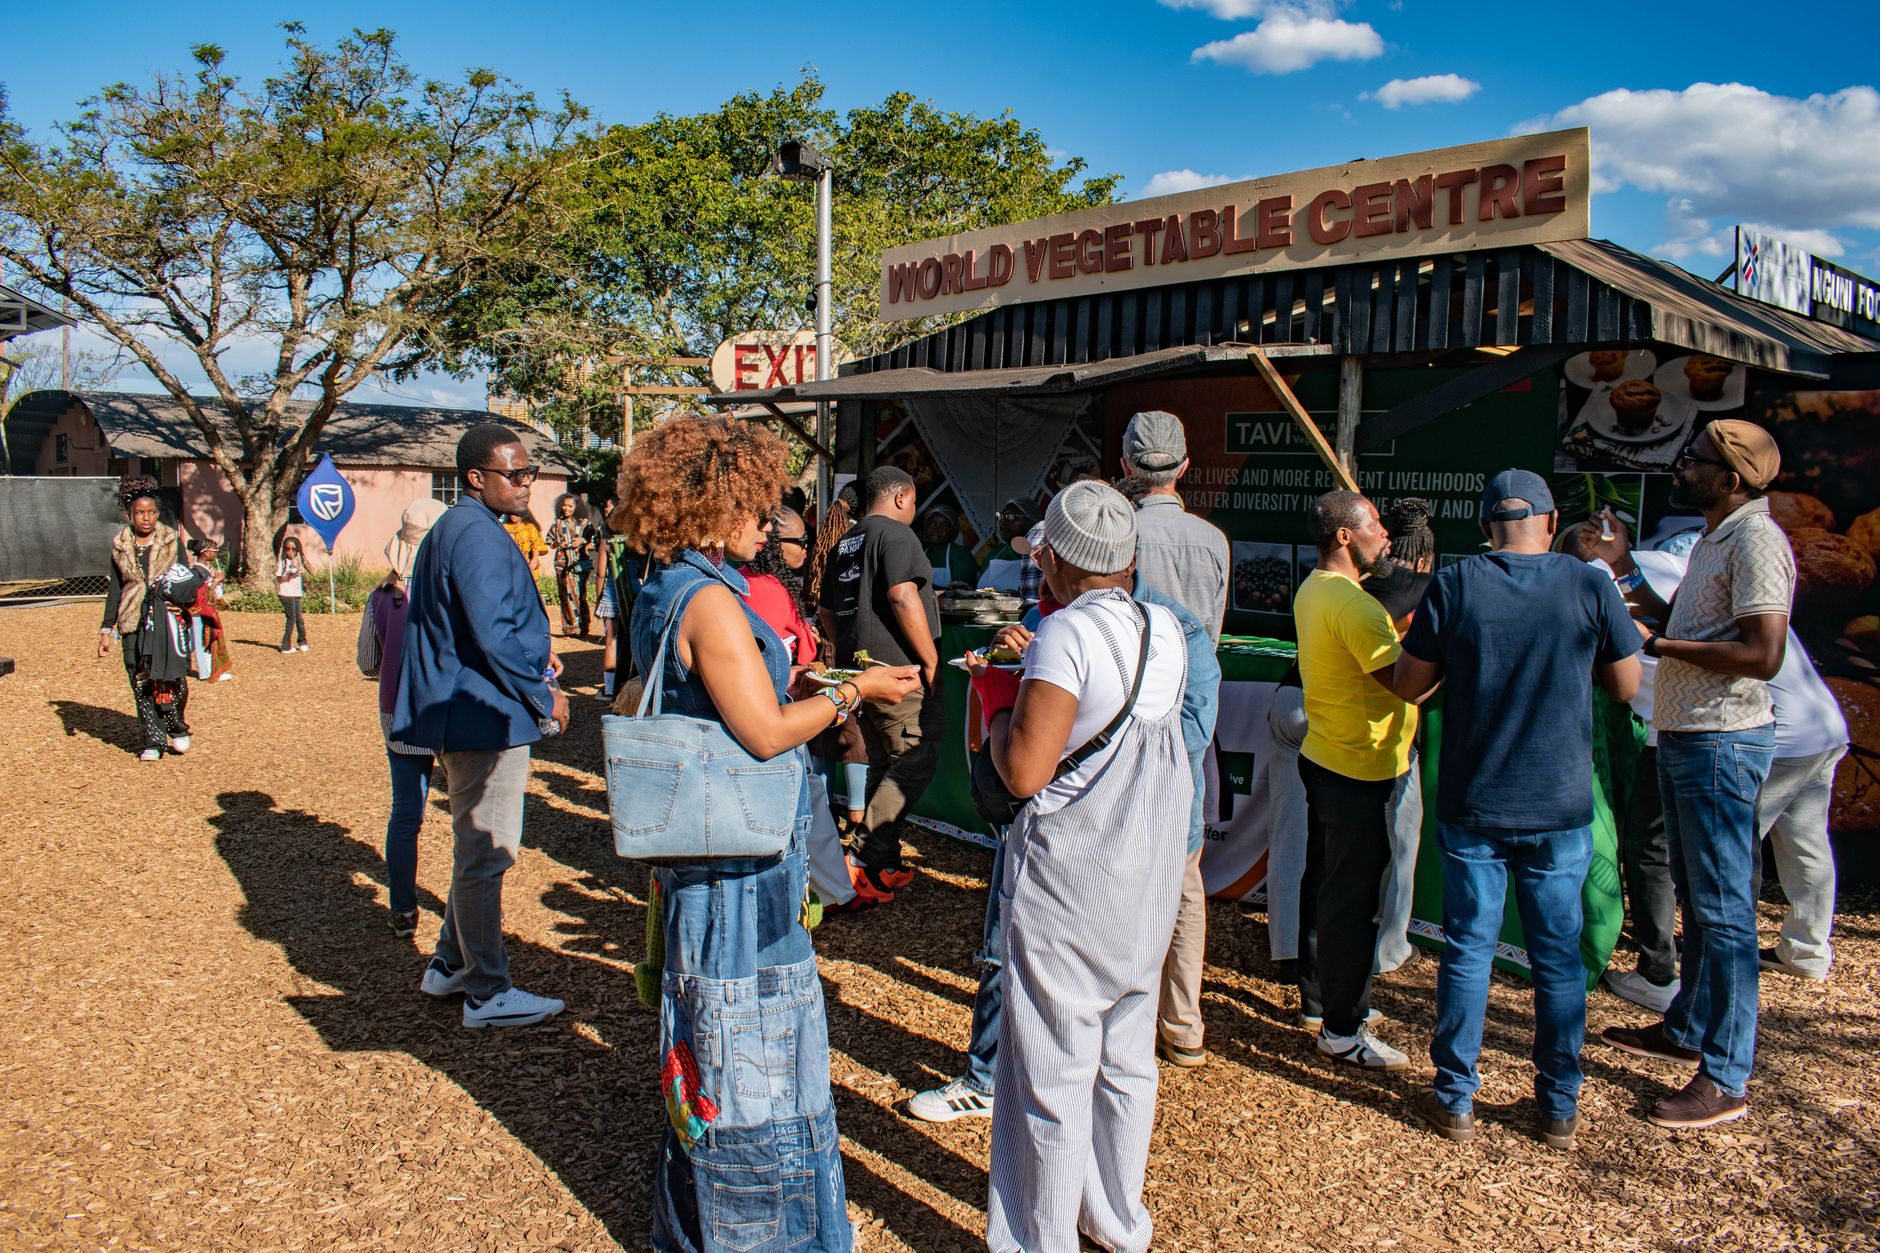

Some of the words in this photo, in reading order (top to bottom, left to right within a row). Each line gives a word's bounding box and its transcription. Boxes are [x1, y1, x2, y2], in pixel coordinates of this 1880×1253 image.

[889, 243, 1014, 303] WORLD
[1024, 194, 1294, 284] VEGETABLE
[1308, 155, 1566, 244] CENTRE
[1811, 266, 1853, 312] NGUNI
[1235, 422, 1291, 445] TAVI
[1206, 468, 1239, 485] LIVES
[1242, 468, 1269, 487] AND
[1272, 469, 1311, 488] MORE
[1388, 471, 1486, 493] LIVELIHOODS
[1233, 492, 1300, 512] DIVERSITY
[1441, 500, 1474, 519] AND
[1229, 773, 1244, 785] ive
